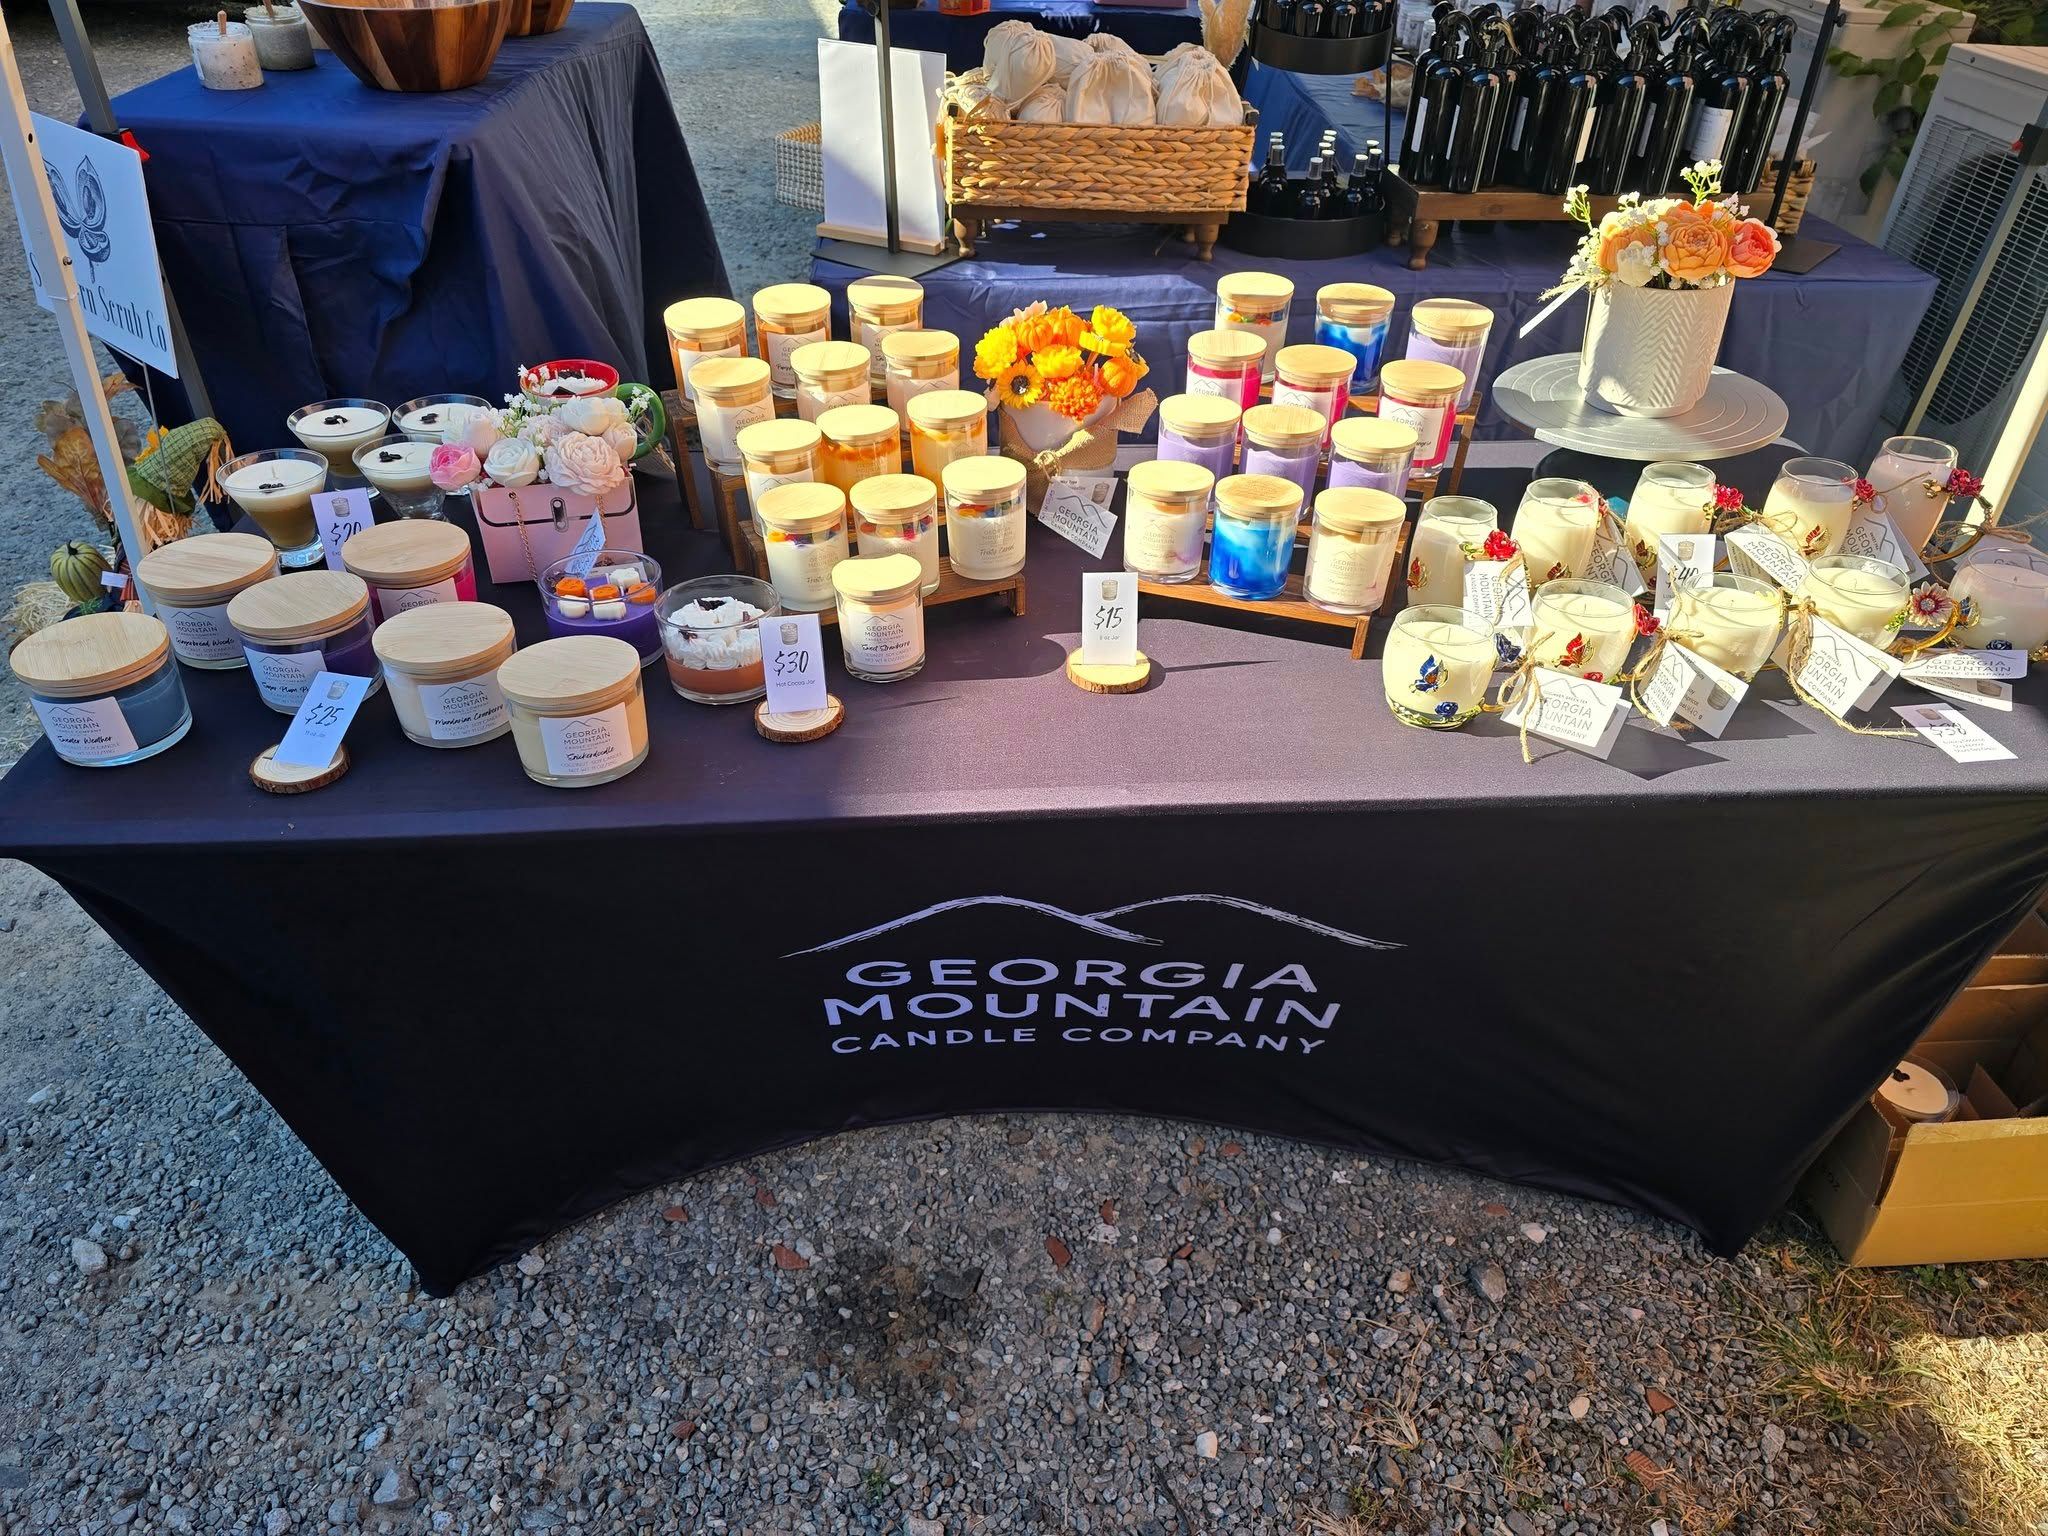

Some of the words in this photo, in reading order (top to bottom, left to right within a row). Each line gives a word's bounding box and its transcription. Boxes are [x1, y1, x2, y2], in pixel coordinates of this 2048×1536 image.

[98, 285, 144, 340] Scrub
[146, 309, 167, 353] Co
[1053, 511, 1099, 545] MOUNTAIN
[1058, 505, 1098, 536] GEORGIA
[1050, 519, 1070, 536] CANDLE
[1070, 533, 1097, 551] COMPANY
[1748, 541, 1799, 586] MOUNTAIN
[1757, 541, 1803, 580] GEORGIA
[400, 598, 438, 608] GEORGIA
[1479, 573, 1494, 619] MOUNTAIN
[175, 620, 213, 628] GEORGIA
[866, 623, 901, 632] GEORGIA
[1094, 605, 1124, 630] $15
[864, 629, 904, 637] MOUNTAIN
[263, 665, 300, 673] GEORGIA
[773, 650, 809, 676] $30
[263, 671, 306, 679] MOUNTAIN
[443, 695, 489, 711] MOUNTAIN
[444, 690, 484, 704] GEORGIA
[1808, 681, 1837, 706] COMPANY
[52, 716, 94, 724] GEORGIA
[305, 703, 345, 727] $25
[1545, 710, 1592, 731] UNTAIN
[53, 722, 100, 730] MOUNTAIN
[565, 726, 607, 739] GEORGIA
[1550, 725, 1587, 740] COMPANY
[84, 735, 112, 744] Weather
[563, 731, 611, 745] MOUNTAIN
[846, 958, 1318, 993] GEORGIA
[823, 993, 1341, 1029] MOUNTAIN
[831, 1028, 1037, 1054] CANDLE
[1062, 1027, 1327, 1055] COMPANY
